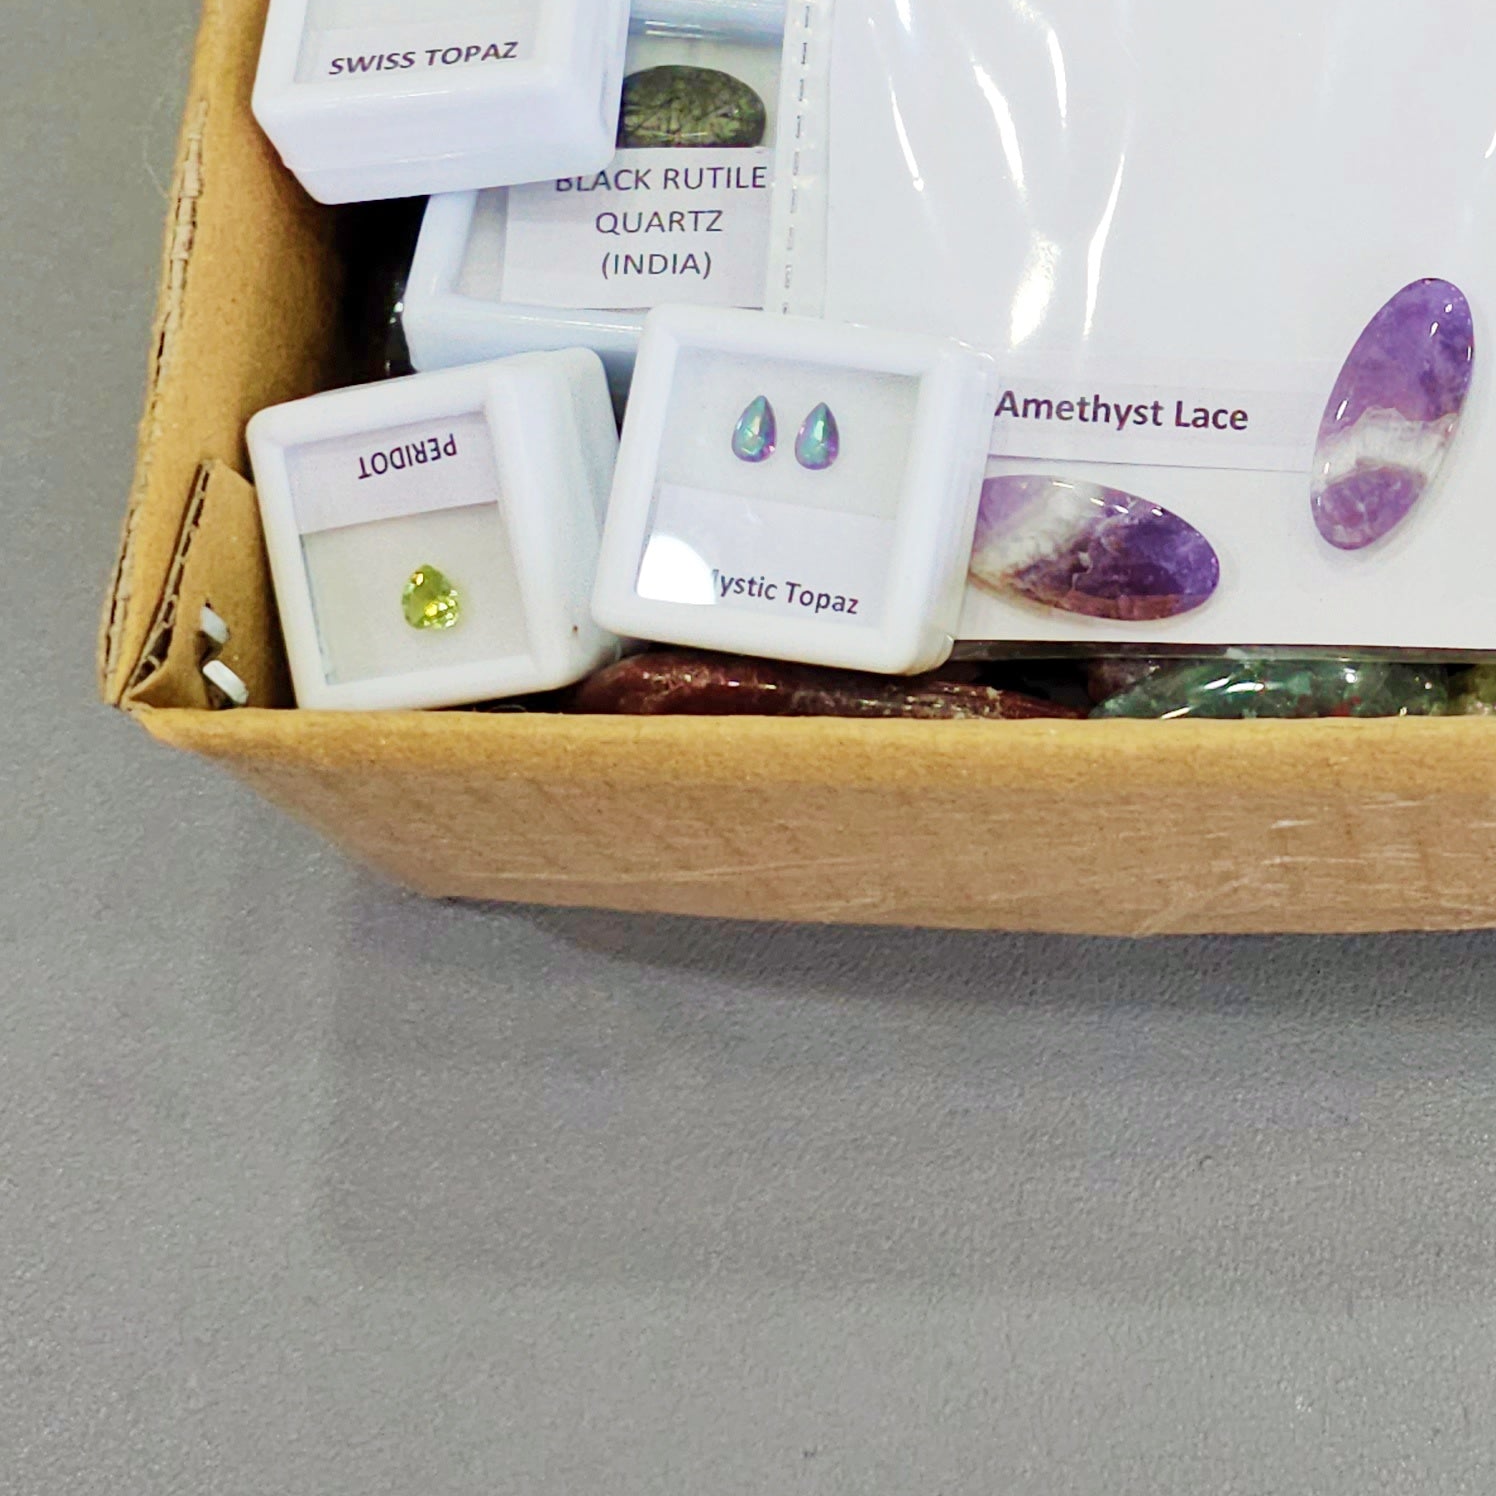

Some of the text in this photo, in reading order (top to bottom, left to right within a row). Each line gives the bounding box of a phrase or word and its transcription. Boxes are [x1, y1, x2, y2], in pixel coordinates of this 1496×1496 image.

[328, 41, 520, 76] SWISS TOPAZ
[555, 166, 768, 192] BLACK RUTILE
[595, 209, 724, 236] QUARTZ
[601, 251, 712, 280] (INDIA)
[994, 389, 1249, 432] Amethyst Lace
[357, 432, 458, 480] PERIDOT
[785, 581, 860, 615] Topaz
